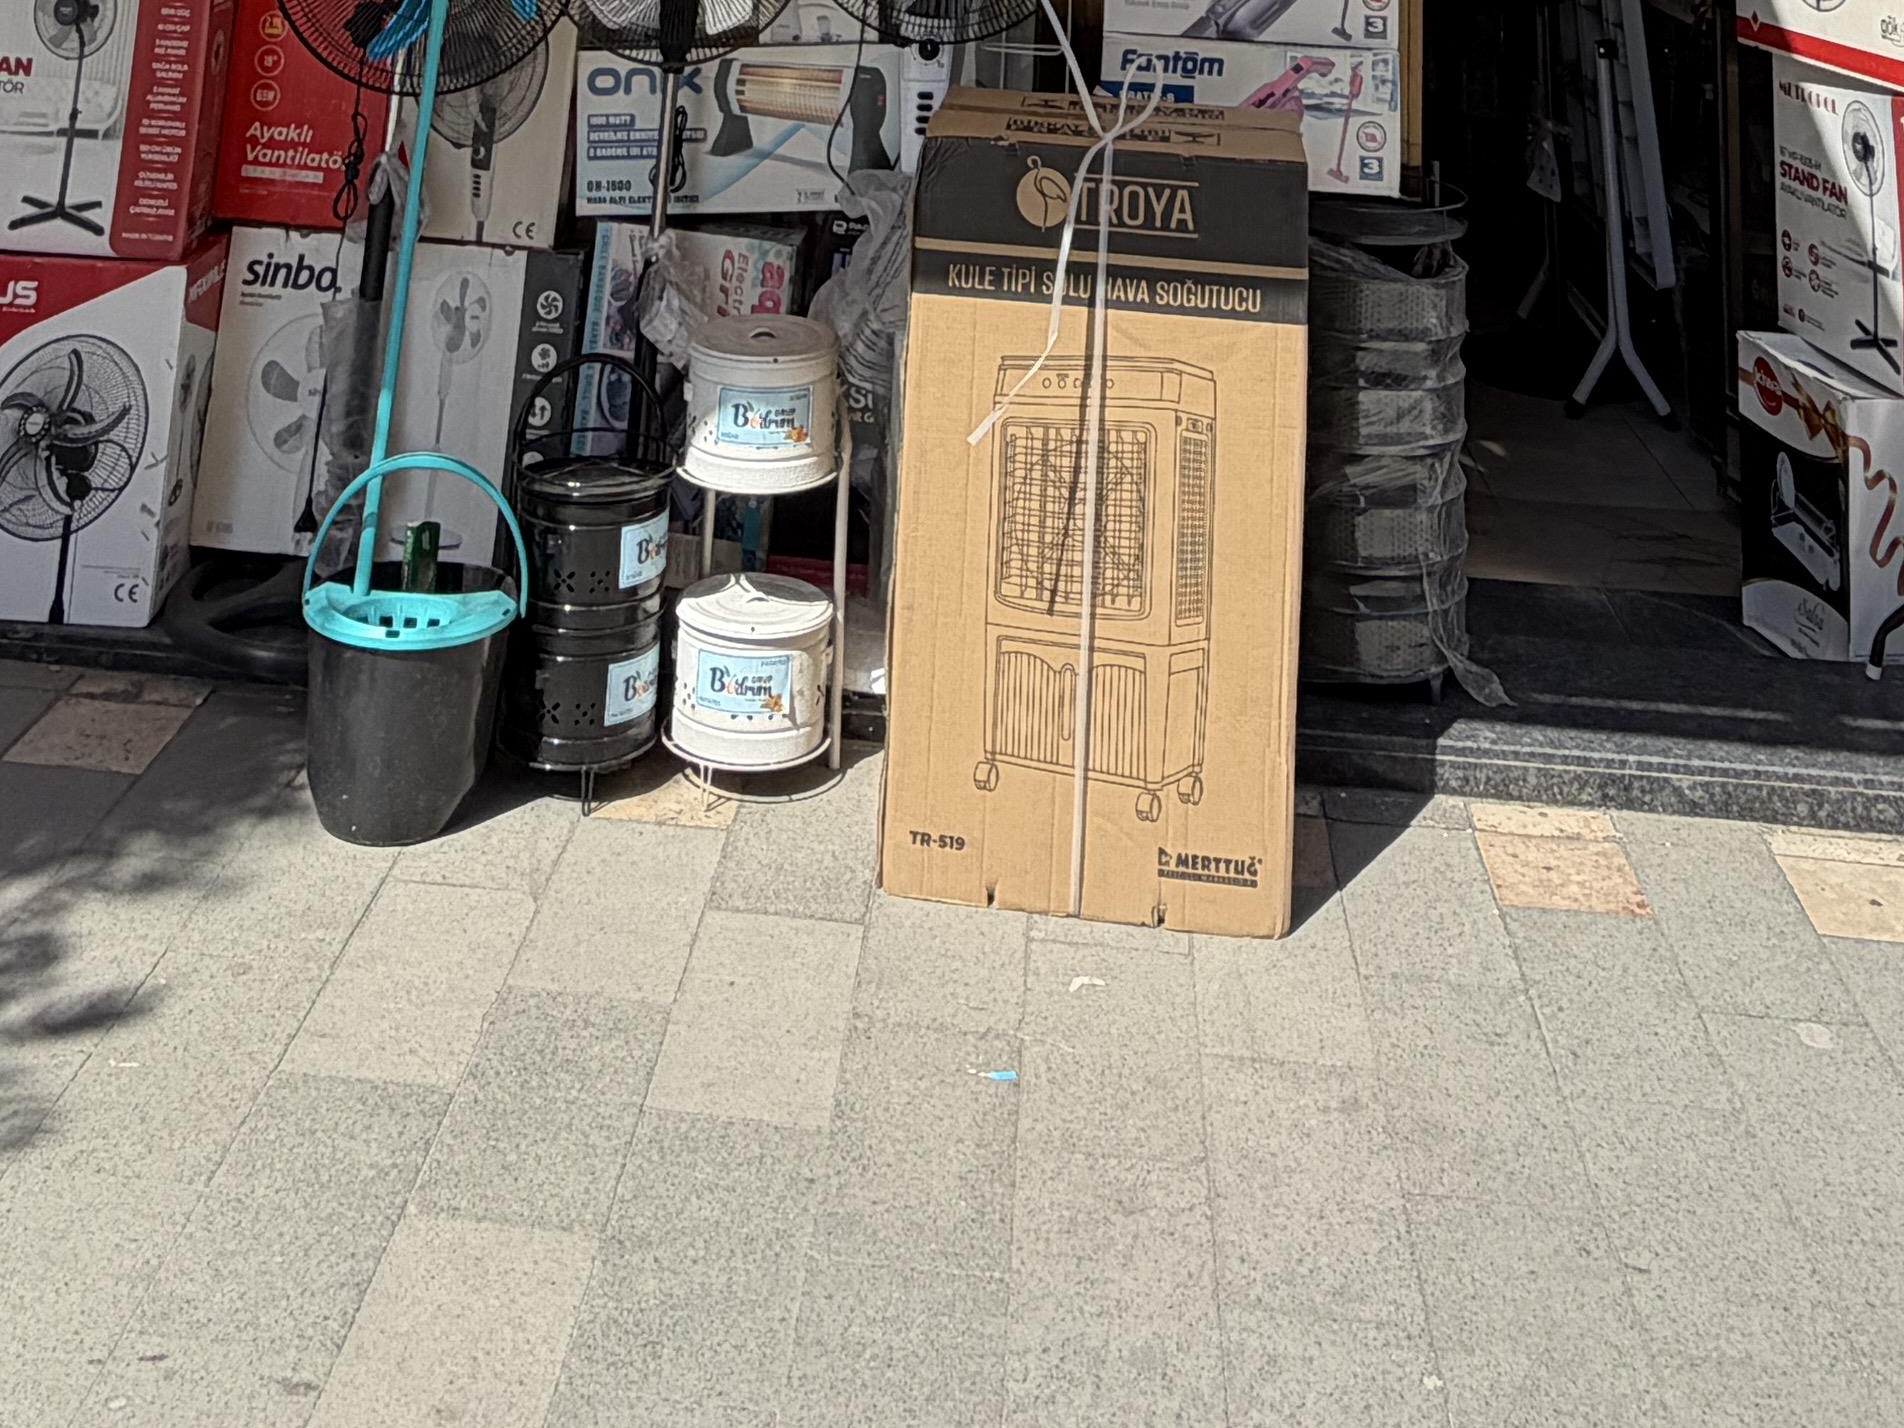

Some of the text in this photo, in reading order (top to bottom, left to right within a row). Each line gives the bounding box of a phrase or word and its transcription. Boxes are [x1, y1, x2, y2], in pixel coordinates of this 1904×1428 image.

[1367, 17, 1384, 32] 3
[587, 66, 703, 96] onx
[246, 120, 314, 143] Ayaklı
[245, 142, 348, 170] Vantilatö
[1364, 158, 1379, 174] 3
[1779, 160, 1849, 207] STAND FAN
[1075, 179, 1194, 232] TROYA
[241, 252, 342, 293] sinbo.
[732, 251, 749, 314] Electr
[948, 263, 995, 291] KULE
[1001, 262, 1036, 293] TİPİ
[1156, 278, 1261, 313] SOĞUTUCU
[709, 665, 773, 697] Bodrum
[908, 830, 966, 851] TR-519
[1175, 850, 1262, 877] MERTTUĞ
